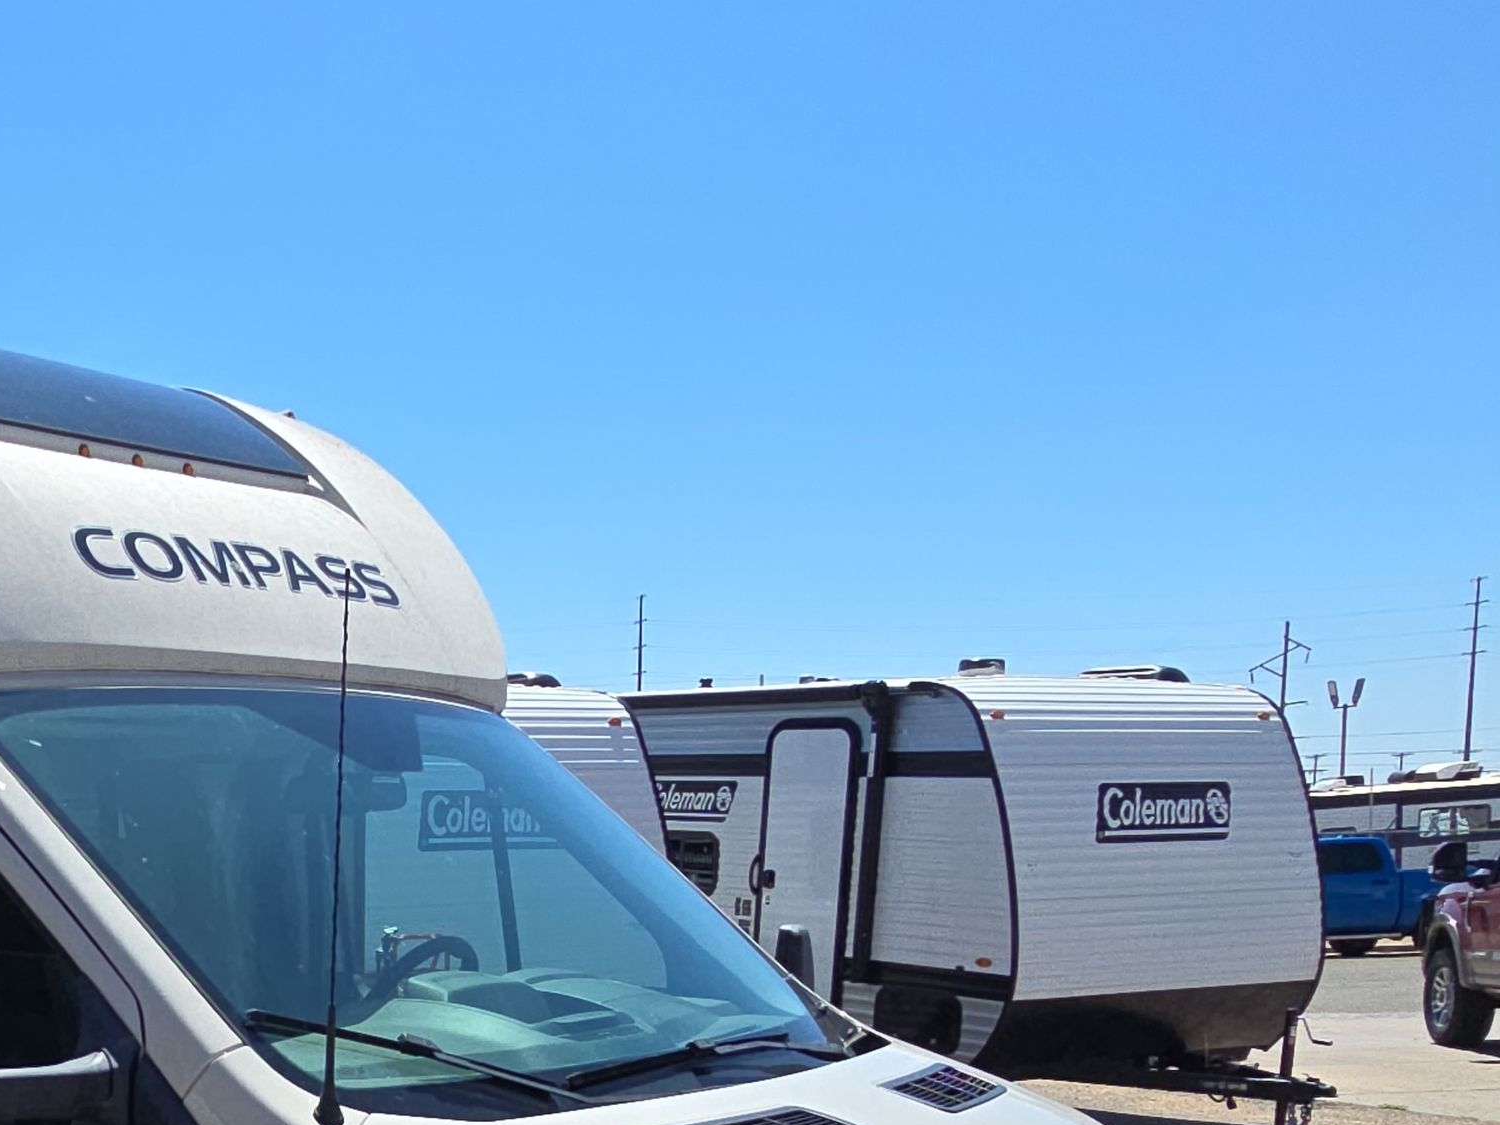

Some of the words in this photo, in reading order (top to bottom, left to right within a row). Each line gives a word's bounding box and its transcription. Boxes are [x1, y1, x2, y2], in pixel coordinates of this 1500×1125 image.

[71, 525, 401, 609] COMPASS
[656, 783, 715, 811] oleman
[1103, 787, 1205, 828] Coleman
